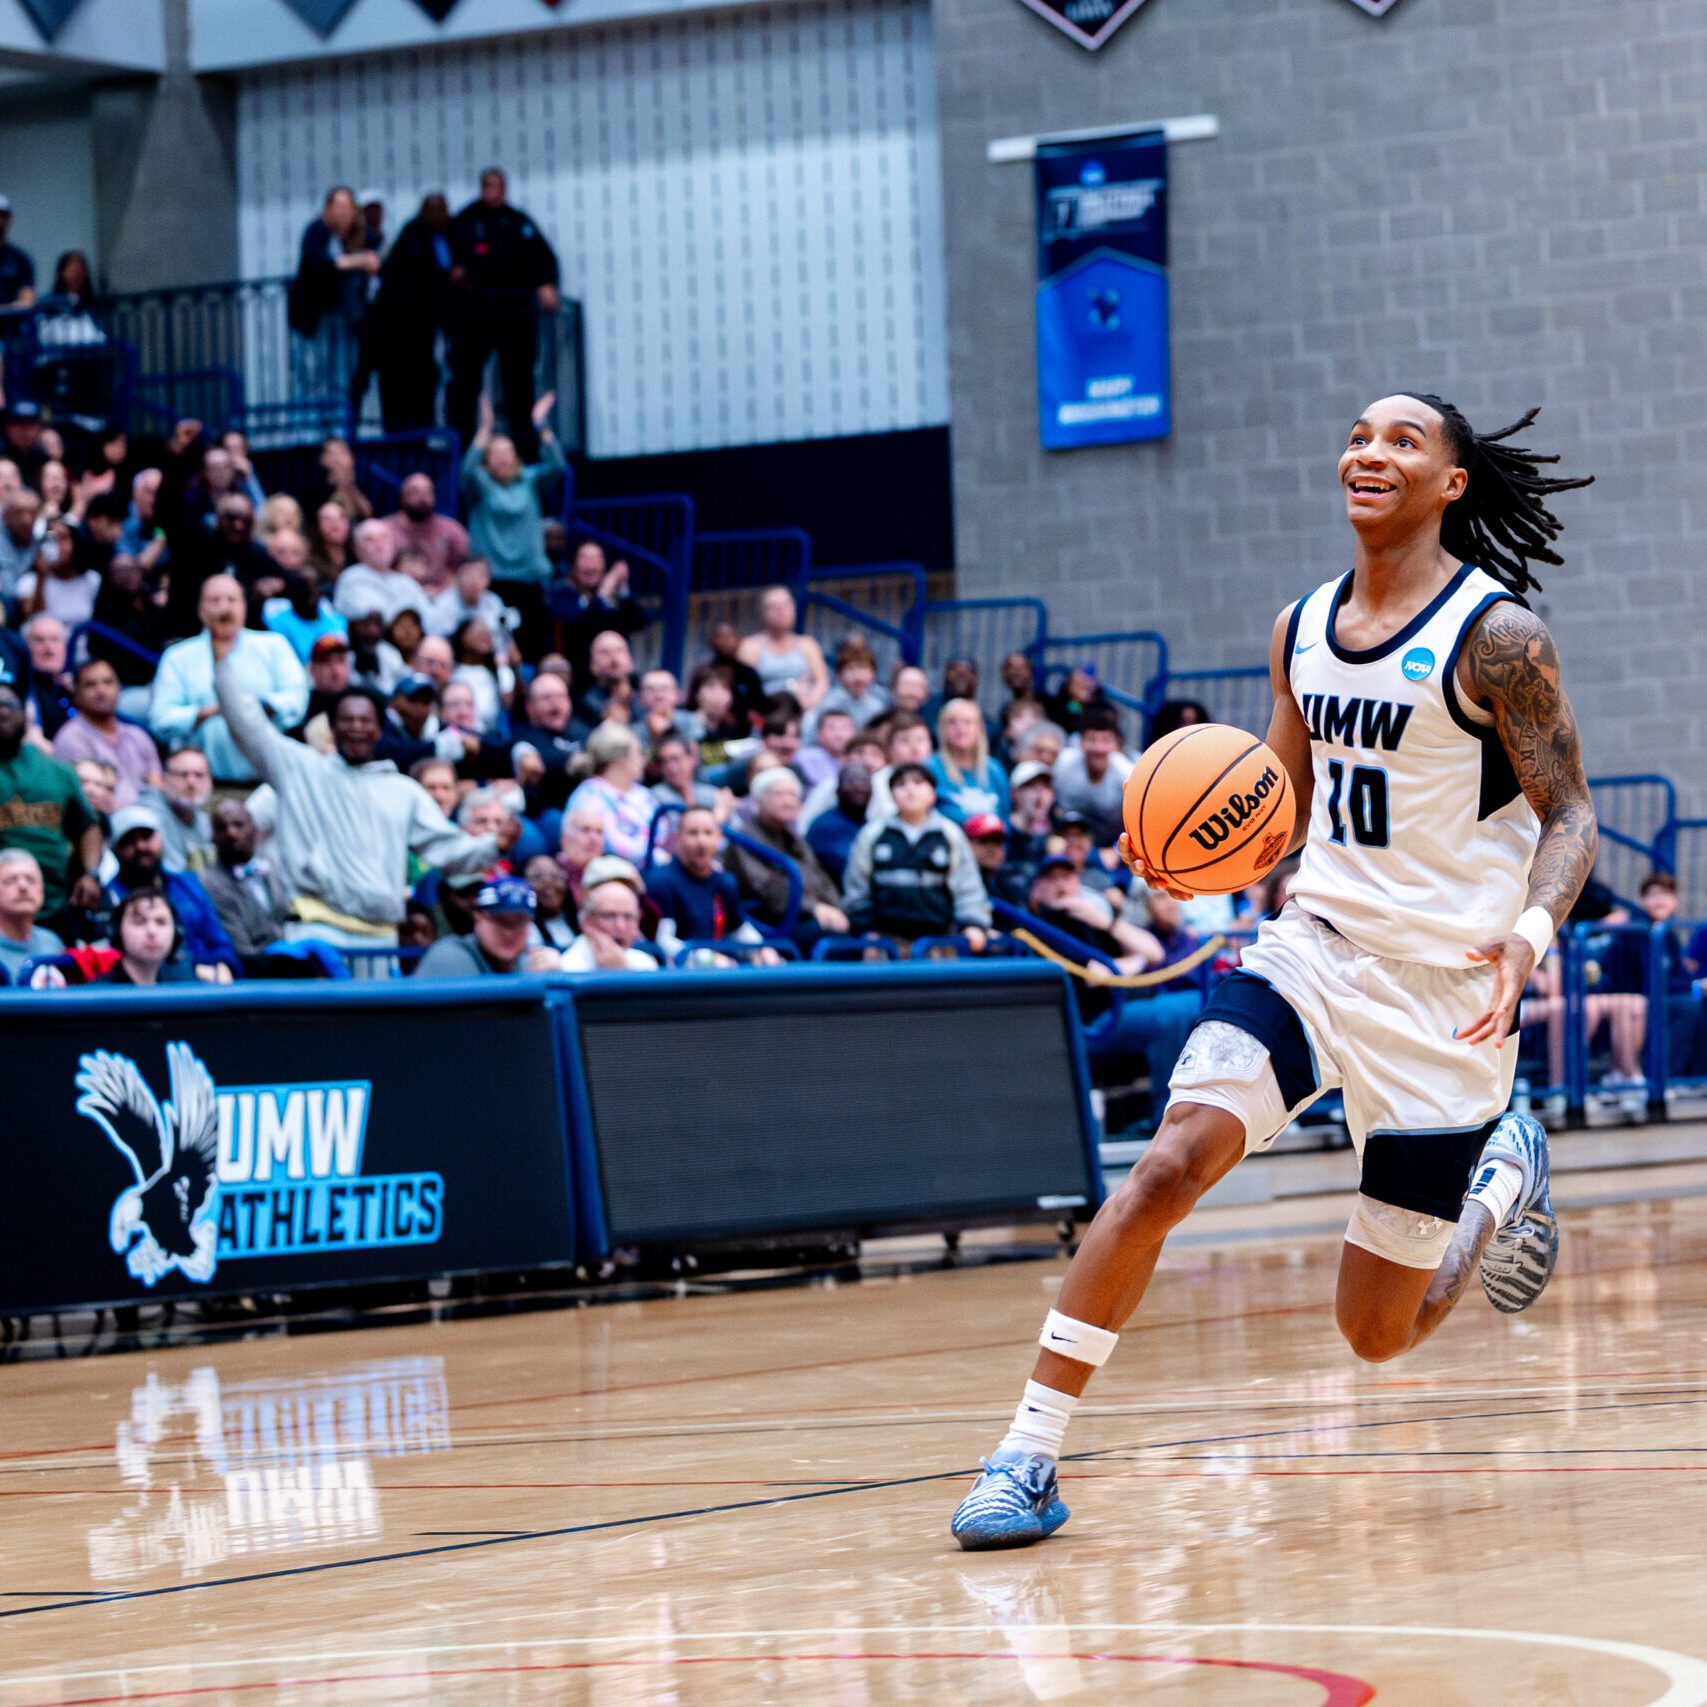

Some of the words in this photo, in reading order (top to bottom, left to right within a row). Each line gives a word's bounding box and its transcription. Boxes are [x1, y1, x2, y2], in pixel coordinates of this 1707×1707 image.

[1404, 660, 1432, 673] NCAA
[1302, 693, 1415, 752] UMW
[1188, 765, 1279, 850] Wilson
[1327, 757, 1389, 849] 10
[217, 1087, 367, 1184] UMW
[217, 1180, 440, 1251] ATHLETICS
